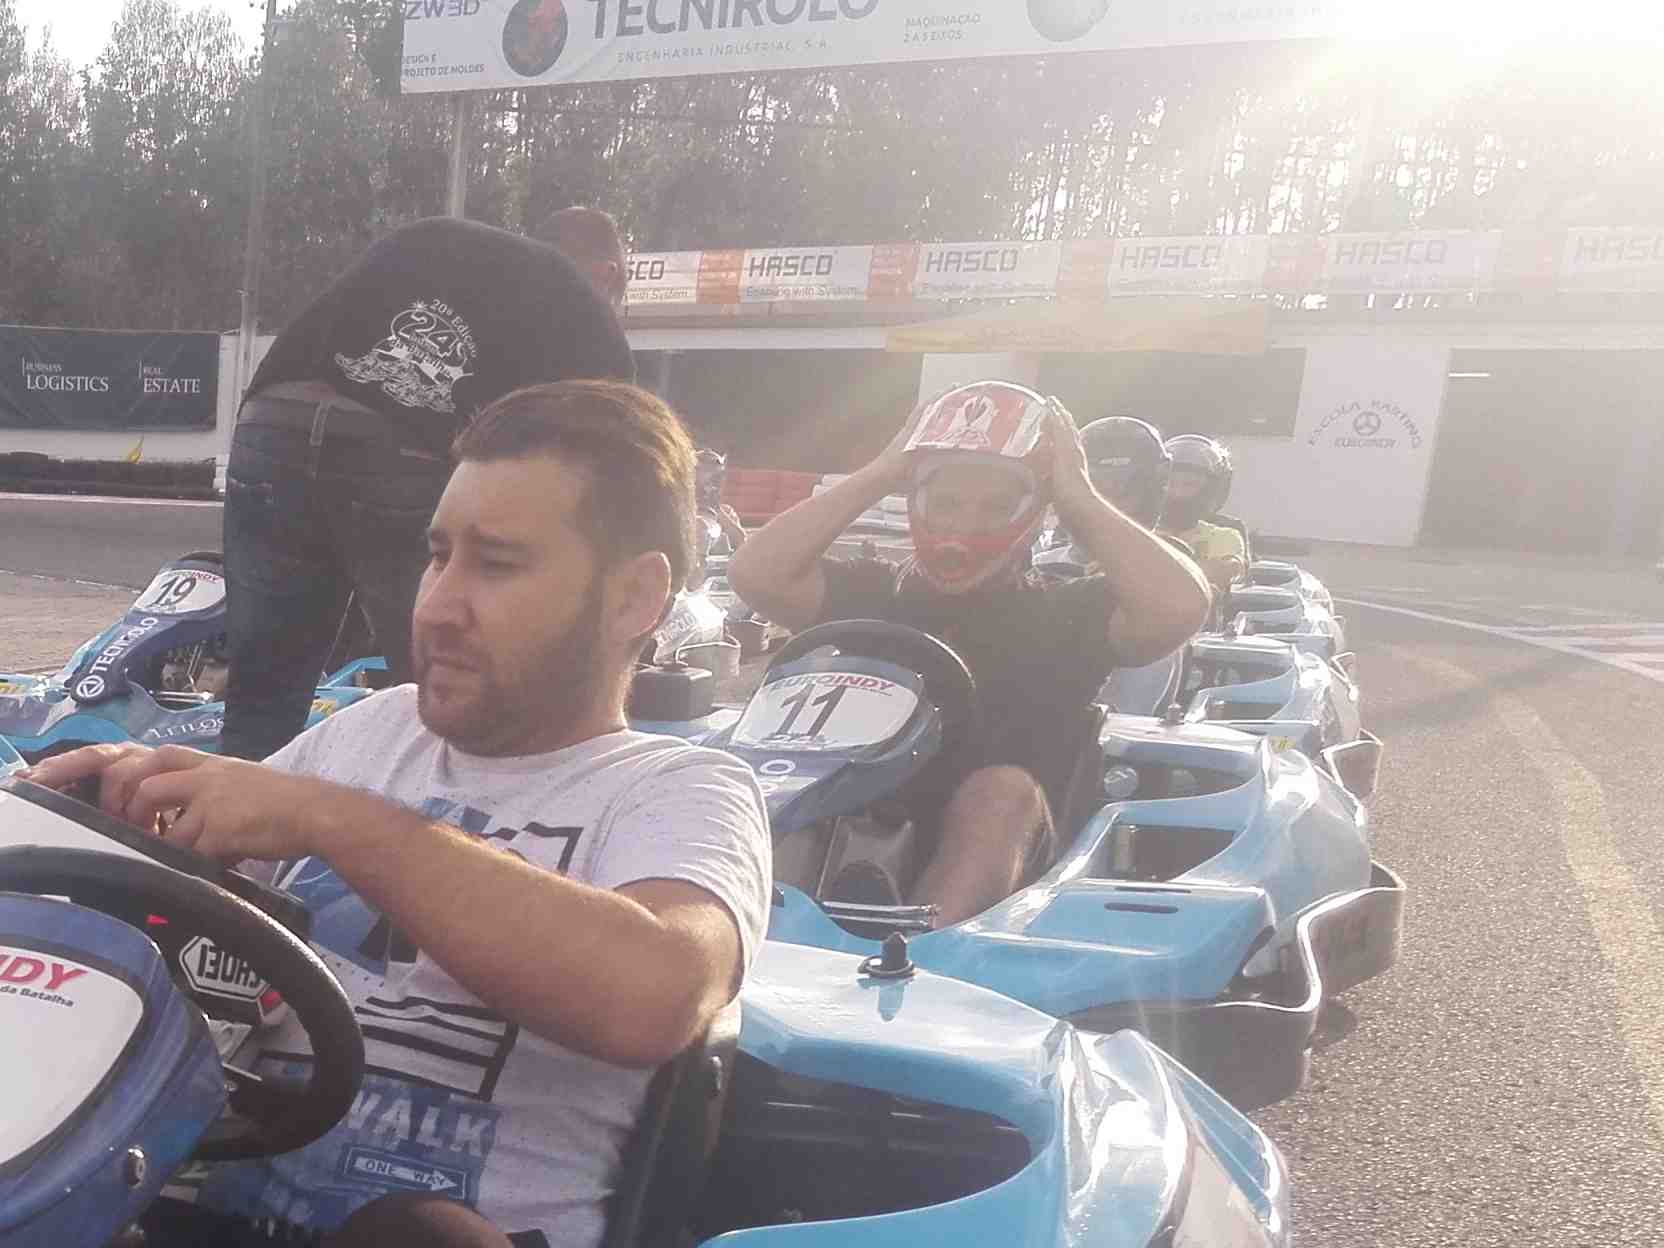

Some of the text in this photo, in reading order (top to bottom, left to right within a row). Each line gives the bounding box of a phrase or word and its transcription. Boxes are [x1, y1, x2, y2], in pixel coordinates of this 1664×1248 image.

[1119, 244, 1221, 269] HASCO
[1334, 238, 1447, 266] HASCO
[1574, 232, 1664, 263] HASC
[627, 260, 665, 281] SCO
[749, 254, 833, 278] HASCO
[926, 248, 1019, 273] HASCO
[26, 375, 110, 392] LOGISTICS
[143, 378, 201, 393] ESTATE
[145, 575, 197, 607] 19
[780, 682, 848, 739] 11
[365, 1158, 447, 1188] ONE WAY
